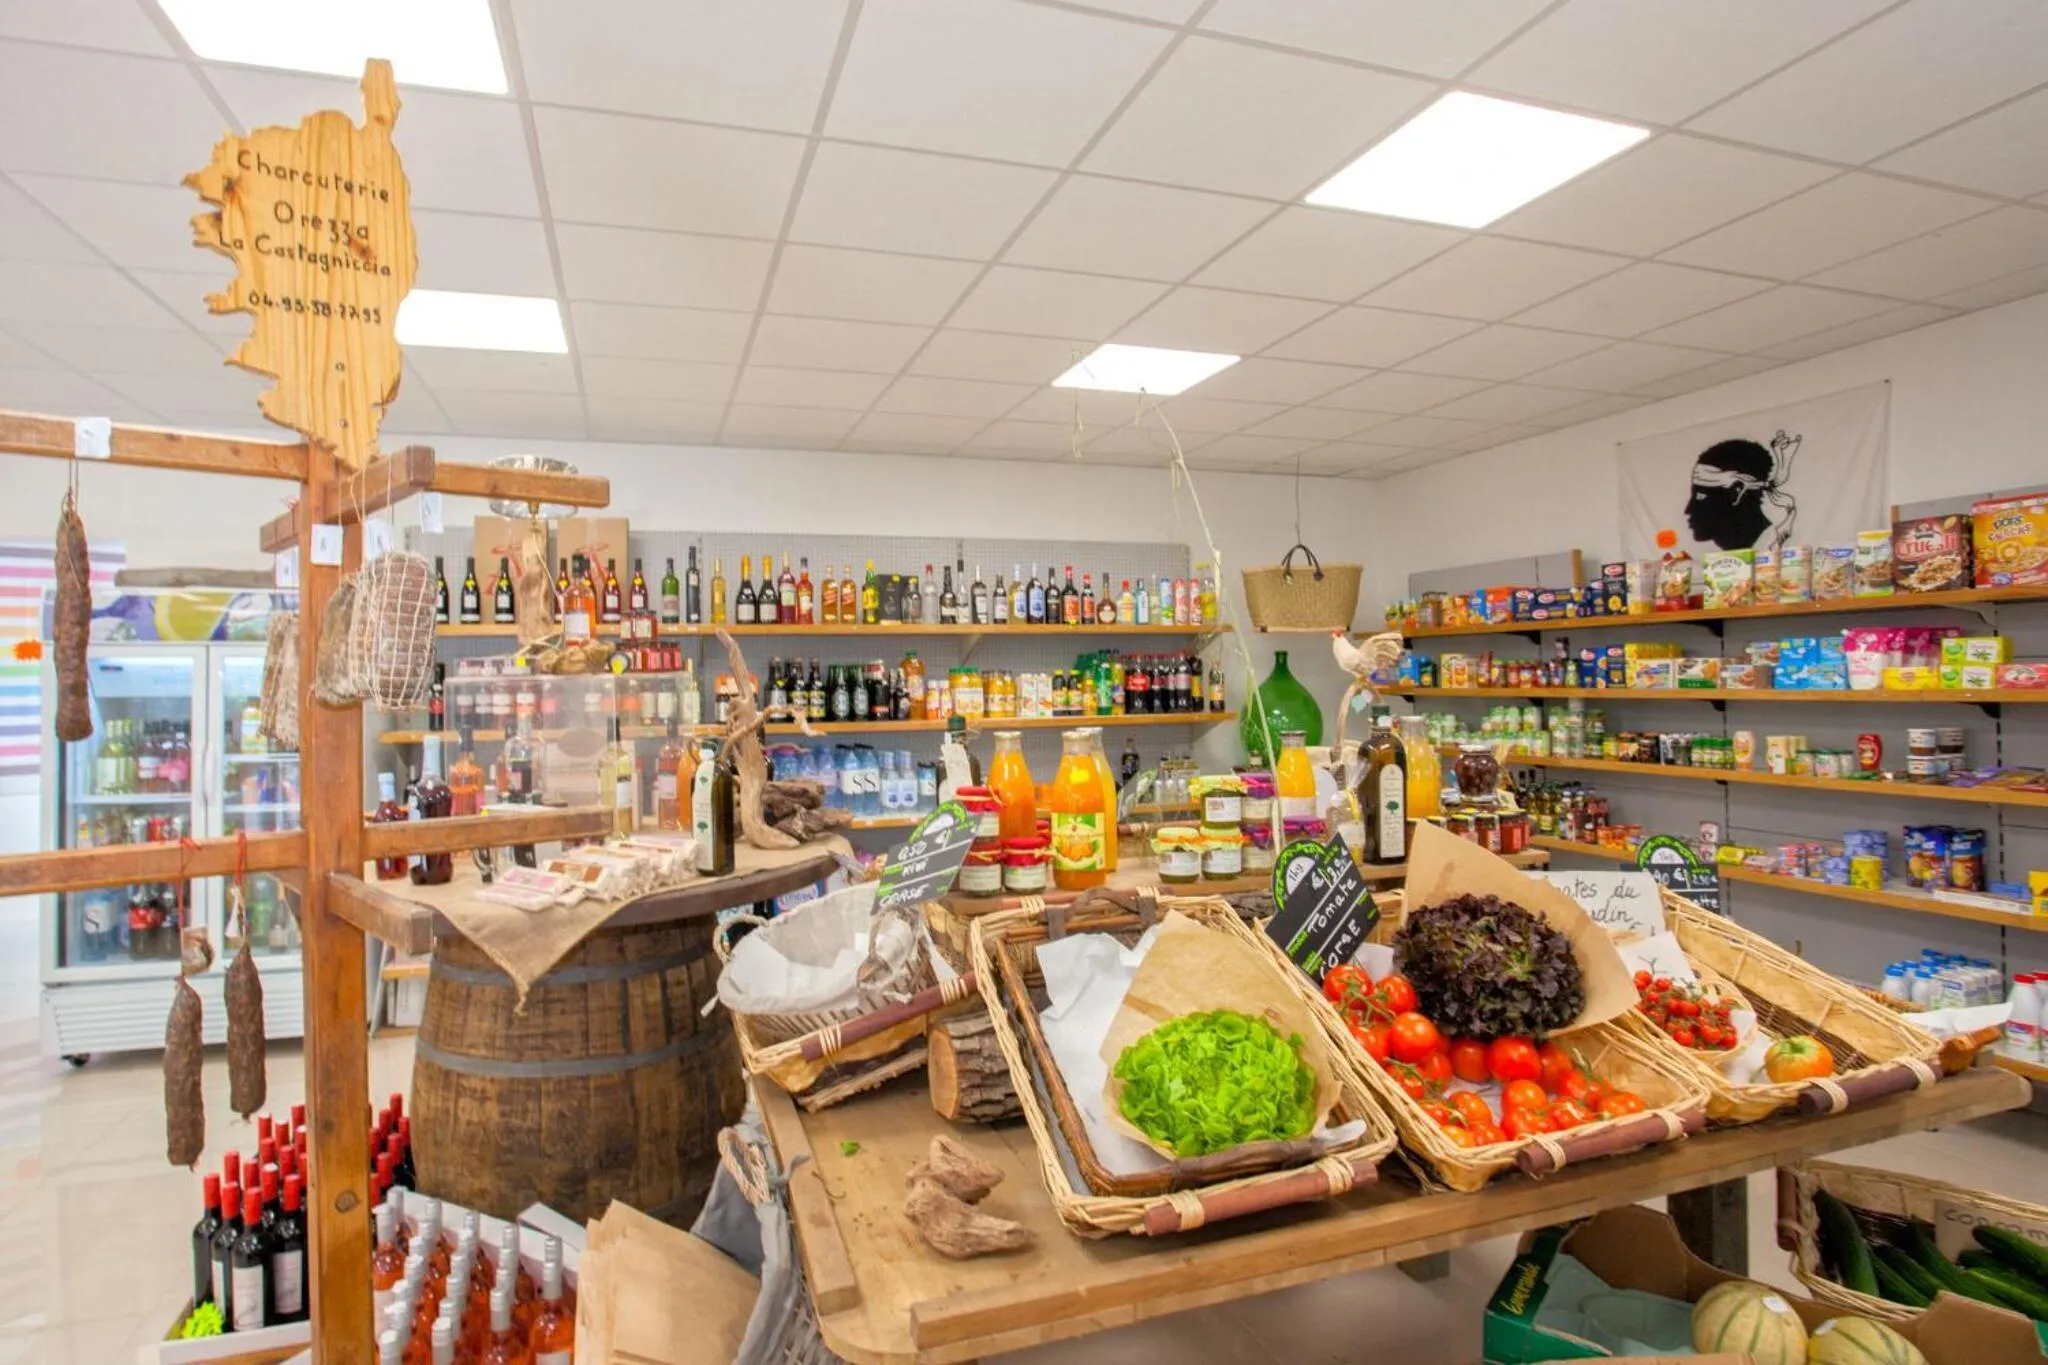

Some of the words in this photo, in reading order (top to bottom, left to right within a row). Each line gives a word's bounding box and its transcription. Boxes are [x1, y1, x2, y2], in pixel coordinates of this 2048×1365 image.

[237, 150, 390, 203] Charcuterie
[219, 231, 244, 250] La
[1307, 878, 1358, 934] Tomate
